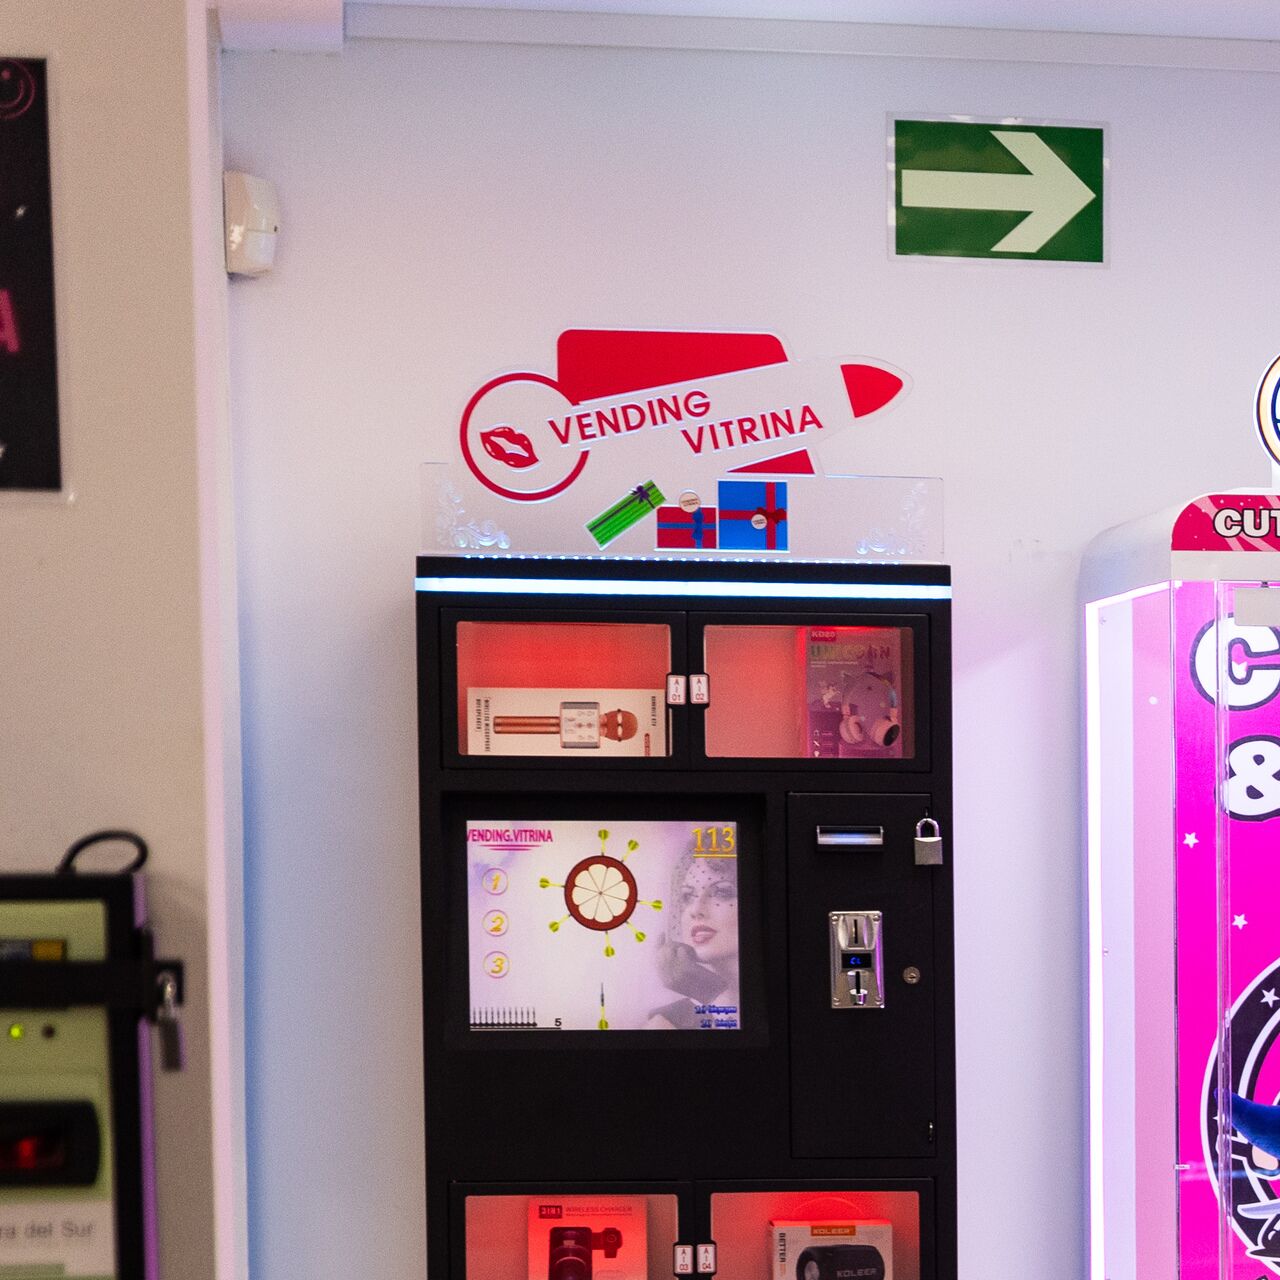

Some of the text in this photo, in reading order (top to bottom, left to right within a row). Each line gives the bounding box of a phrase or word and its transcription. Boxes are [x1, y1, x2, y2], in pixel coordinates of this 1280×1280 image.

[547, 390, 711, 446] VENDING
[680, 404, 824, 455] VITRINA
[692, 827, 736, 852] 113
[489, 915, 505, 932] 2
[490, 957, 505, 974] 3
[554, 1018, 562, 1027] 5
